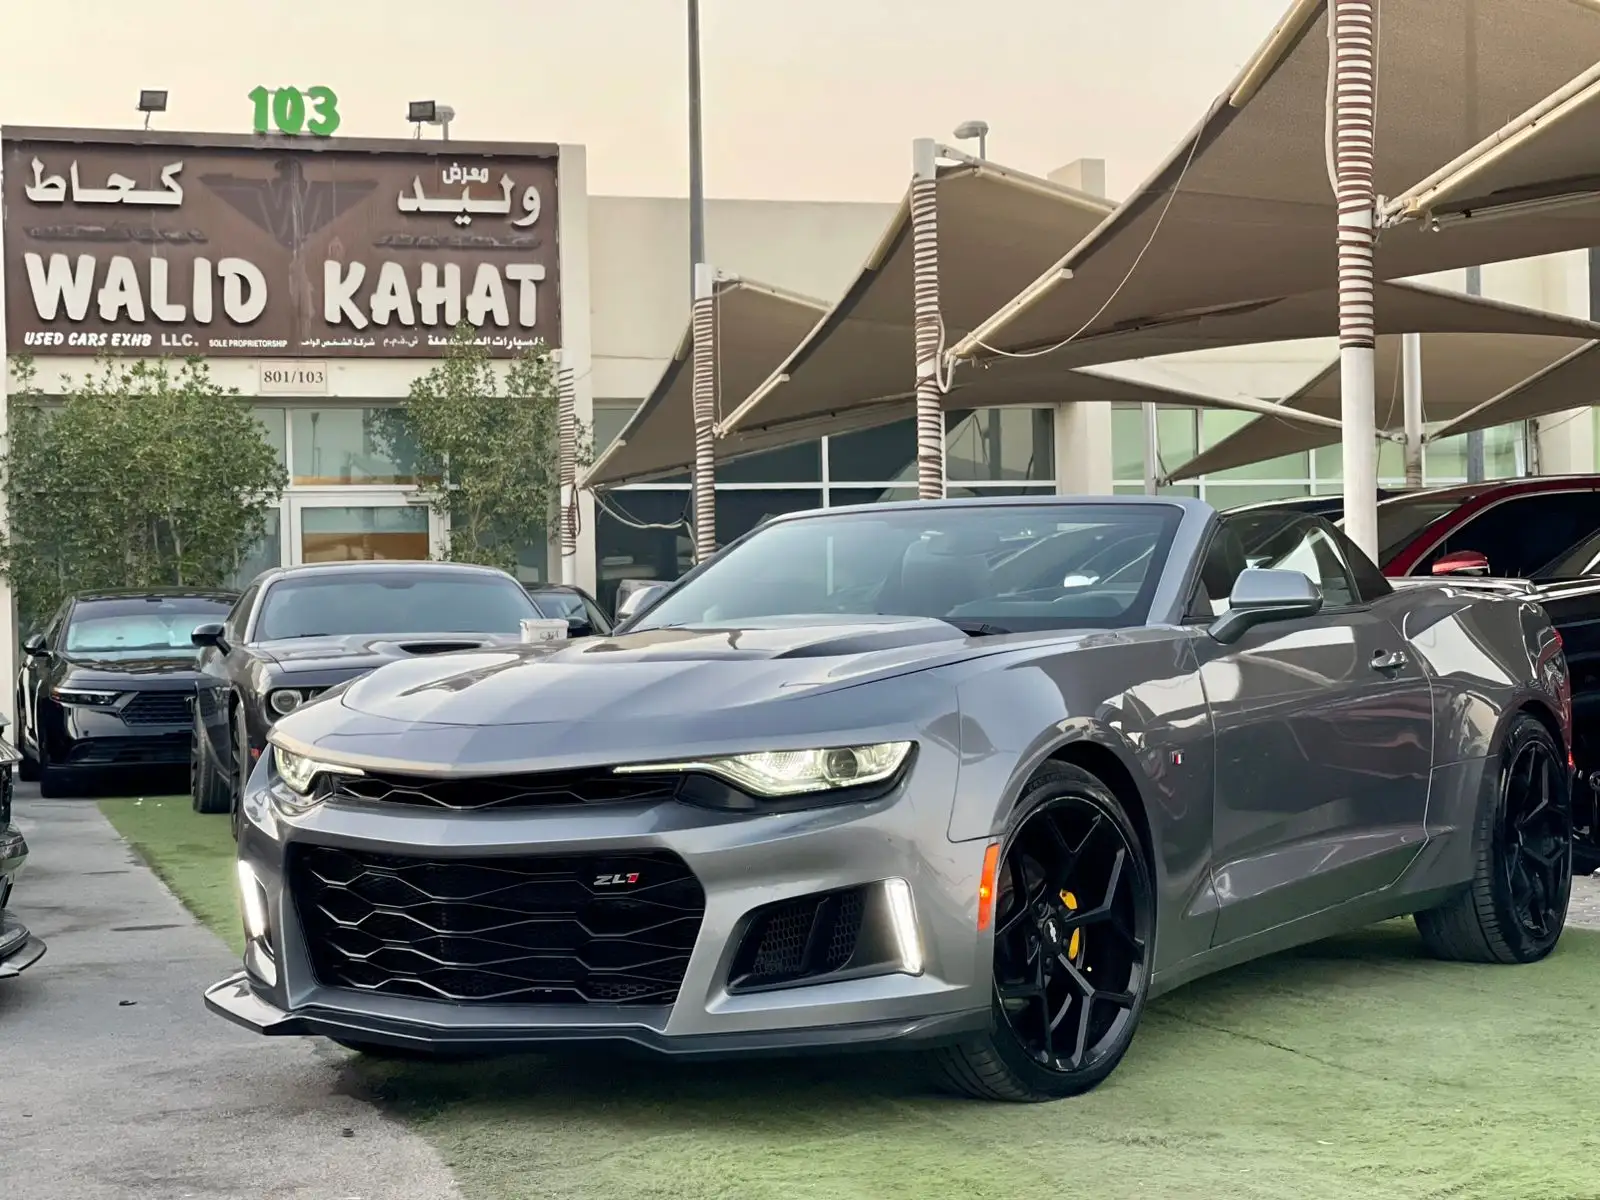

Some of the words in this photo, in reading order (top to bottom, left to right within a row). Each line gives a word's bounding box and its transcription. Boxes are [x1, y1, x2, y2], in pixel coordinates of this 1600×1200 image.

[247, 84, 341, 136] 103
[25, 156, 183, 206] كحاط
[442, 162, 489, 184] معرض
[397, 172, 541, 227] وليد
[24, 252, 267, 324] WALID
[324, 259, 545, 330] KAHAT
[24, 331, 64, 346] USED
[67, 332, 107, 347] CARS
[208, 339, 228, 348] SOLE
[228, 339, 288, 348] PROPRIETORSHIP
[263, 370, 324, 384] 801/103
[593, 872, 640, 886] ZL1
